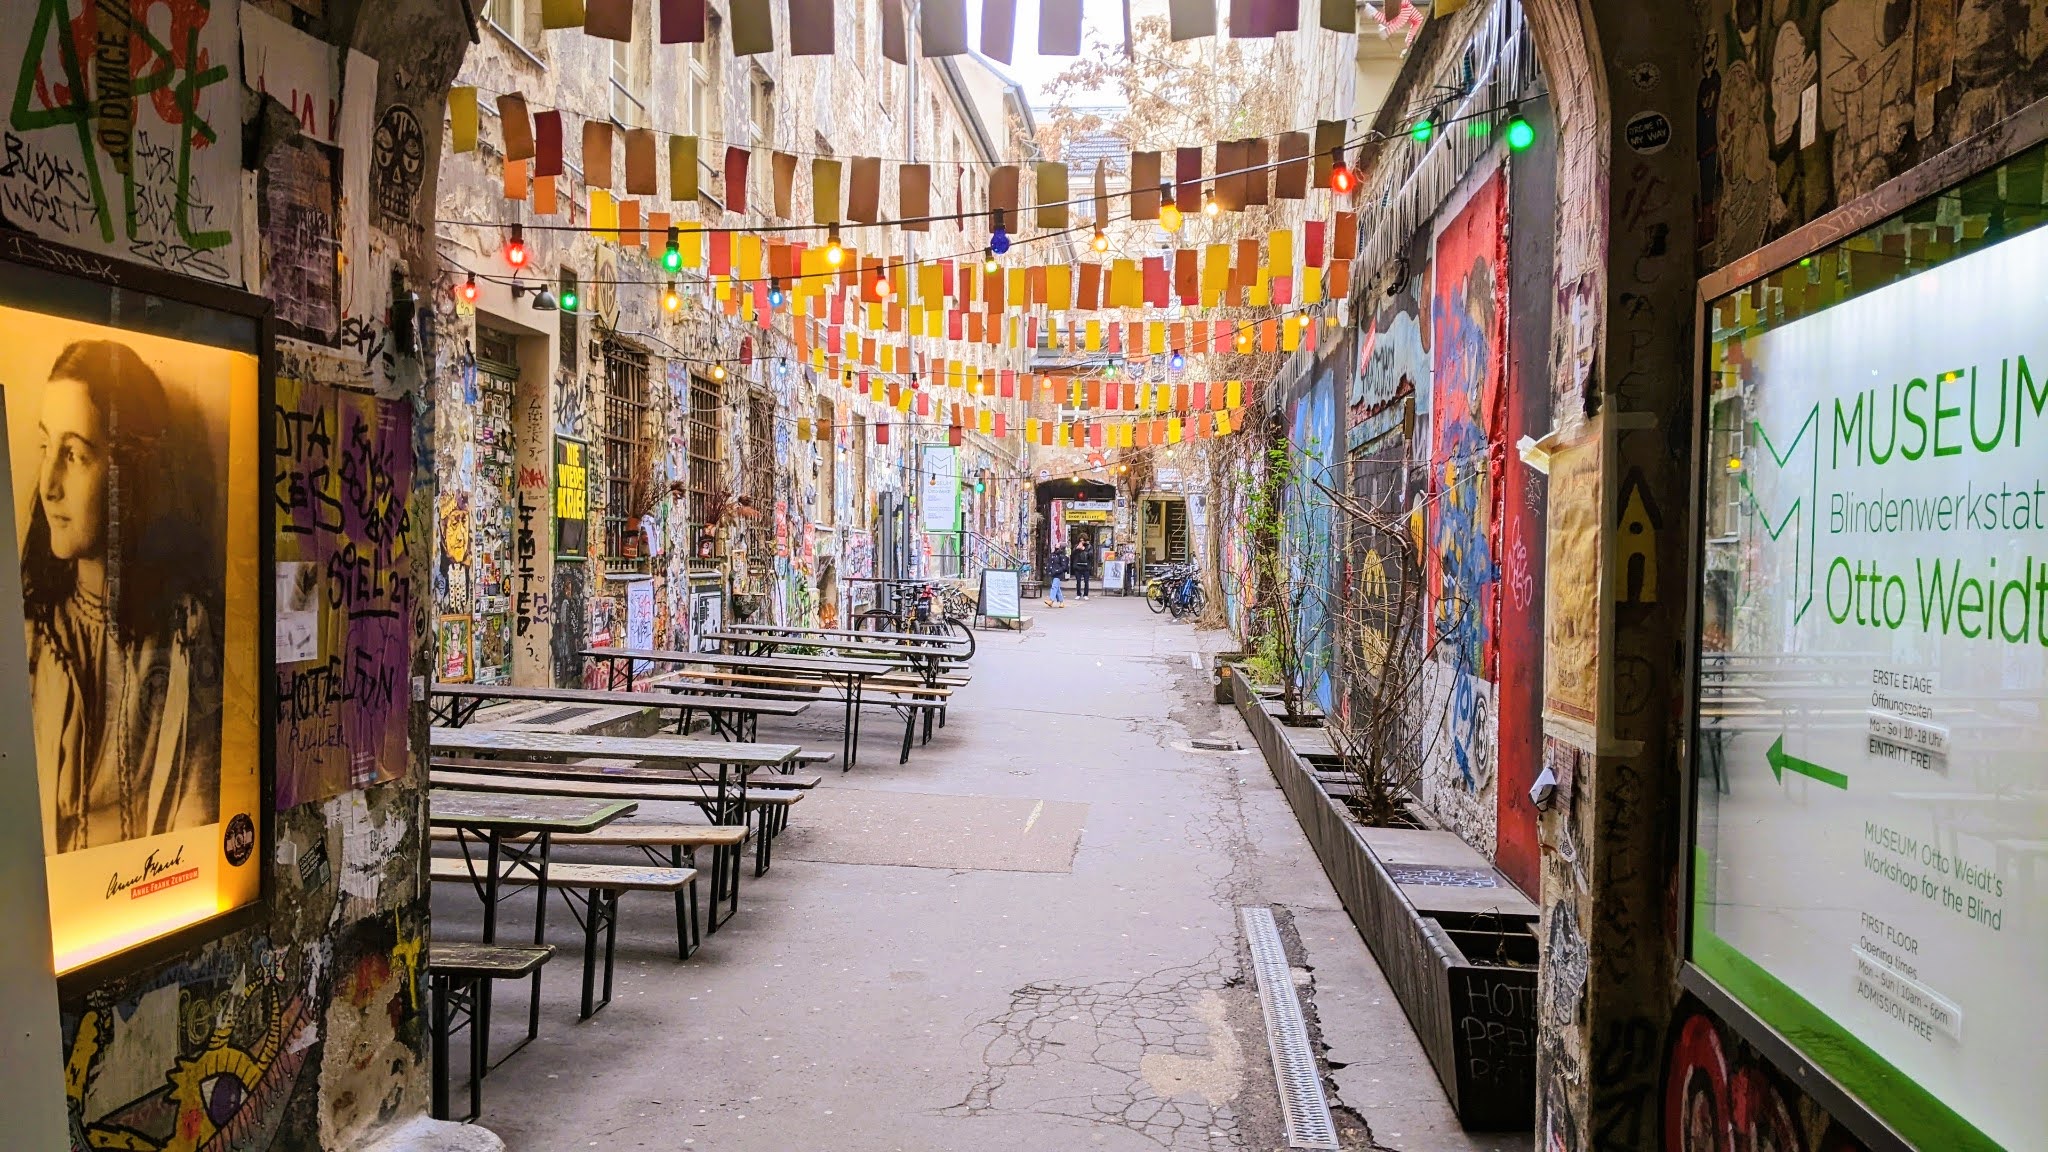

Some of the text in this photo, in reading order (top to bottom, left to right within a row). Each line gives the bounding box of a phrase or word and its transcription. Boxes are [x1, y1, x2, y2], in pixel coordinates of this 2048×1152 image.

[1646, 128, 1667, 142] WAY
[1832, 355, 2048, 470] MUSEUM
[565, 442, 580, 467] NIE
[1830, 479, 2046, 534] Blindenwerkstat
[517, 491, 536, 638] LIMITED
[1826, 555, 2048, 648] Otto Weidt
[1873, 669, 1932, 694] ERSTE ETAGE
[1871, 689, 1933, 720] Öffnungszeiten
[1869, 718, 1880, 732] Mo
[1887, 722, 1897, 736] So
[1904, 726, 1913, 740] 10
[1928, 732, 1943, 748] Uhr
[1869, 739, 1931, 770] EINTRITT FREI
[1865, 820, 2003, 898] MUSEUM Otto Weidt's
[150, 878, 170, 893] FRANK
[170, 871, 199, 887] ZENTRUM
[1863, 848, 2002, 931] Workshop for the Blind
[1861, 911, 1918, 955] FIRST FLOOR
[1860, 935, 1918, 980] Opening times
[1857, 982, 1932, 1042] ADMISSION FREE
[1858, 958, 1873, 977] Mon
[1881, 972, 1895, 993] Sun
[1901, 985, 1922, 1008] 10am
[1930, 1003, 1948, 1025] 6pm
